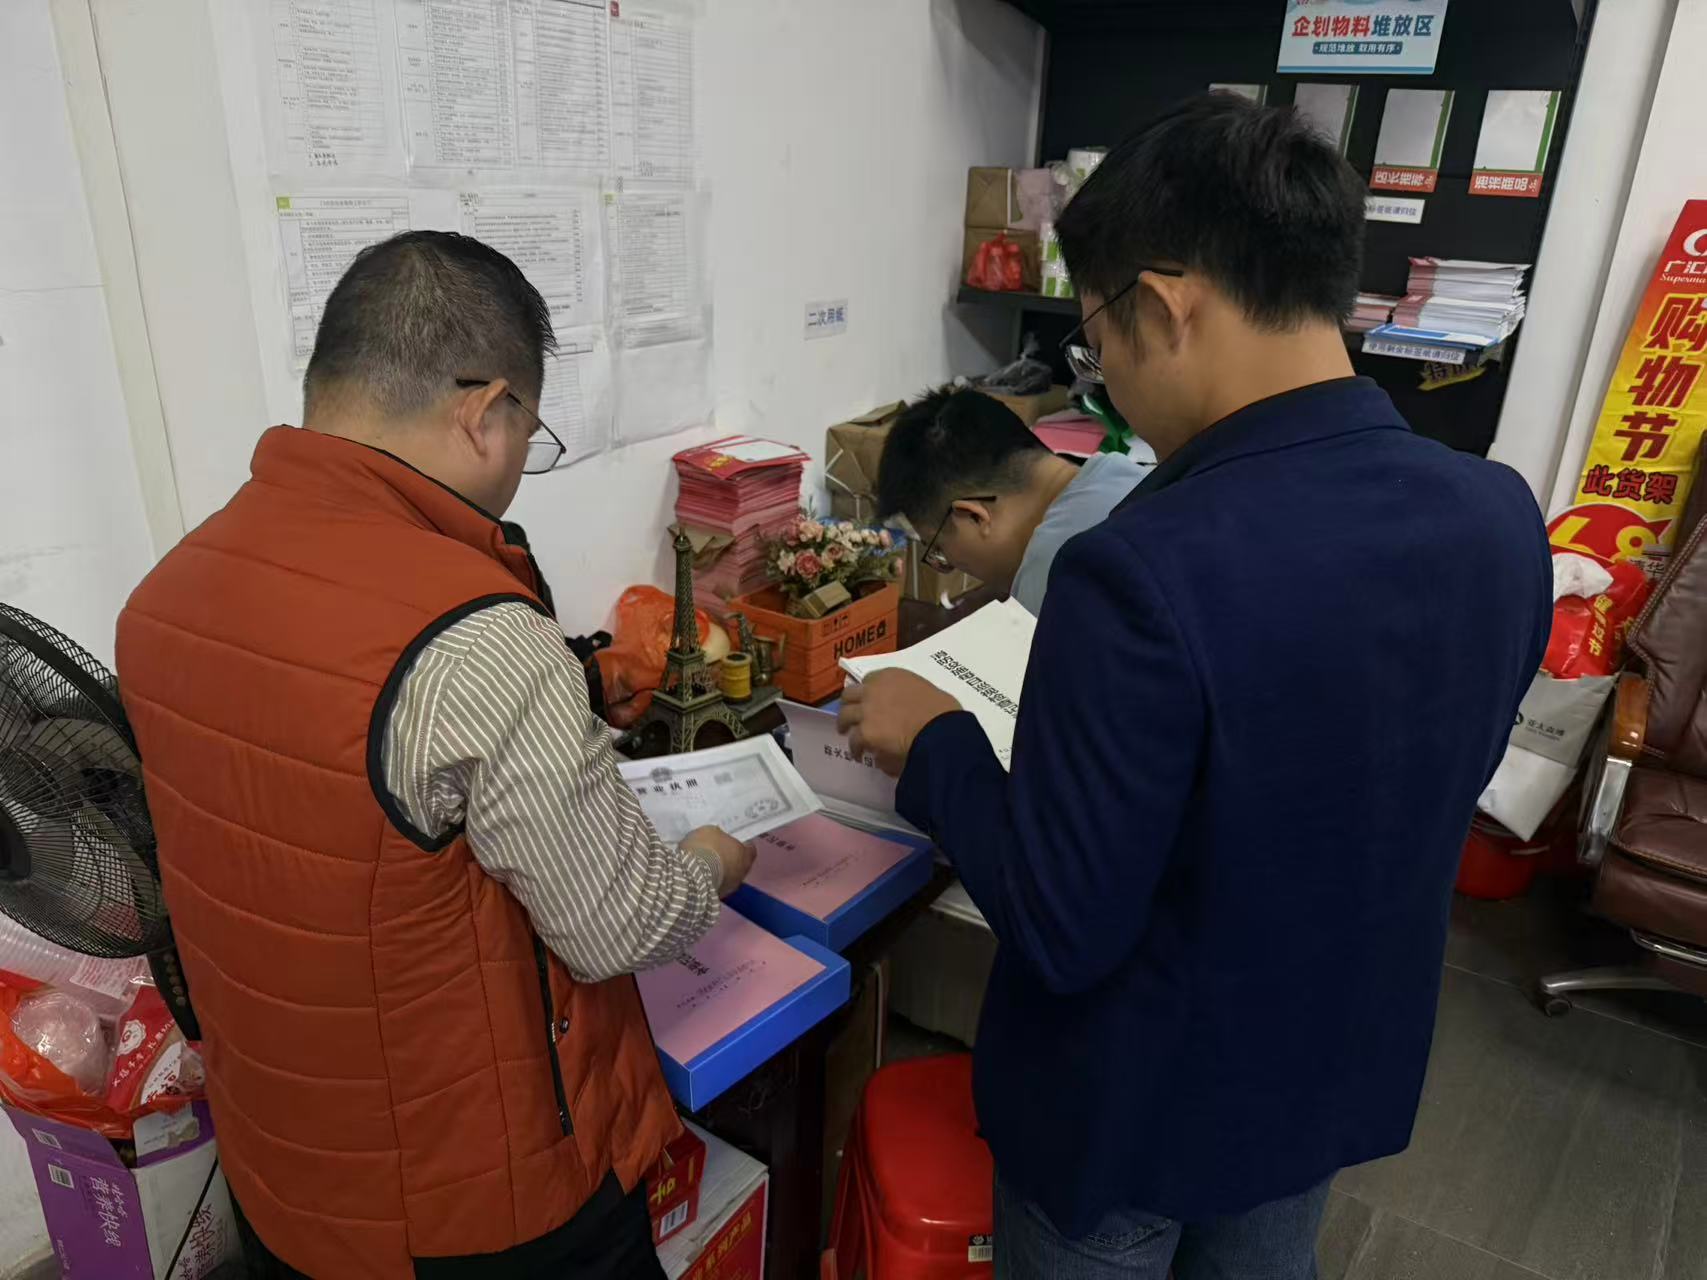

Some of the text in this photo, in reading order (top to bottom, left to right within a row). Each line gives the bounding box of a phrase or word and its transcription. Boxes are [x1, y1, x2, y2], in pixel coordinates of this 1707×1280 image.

[1292, 14, 1435, 37] 企划物料堆放区
[1581, 464, 1680, 505] 此货架
[833, 624, 876, 661] HOME
[89, 1176, 122, 1249] 营养快线
